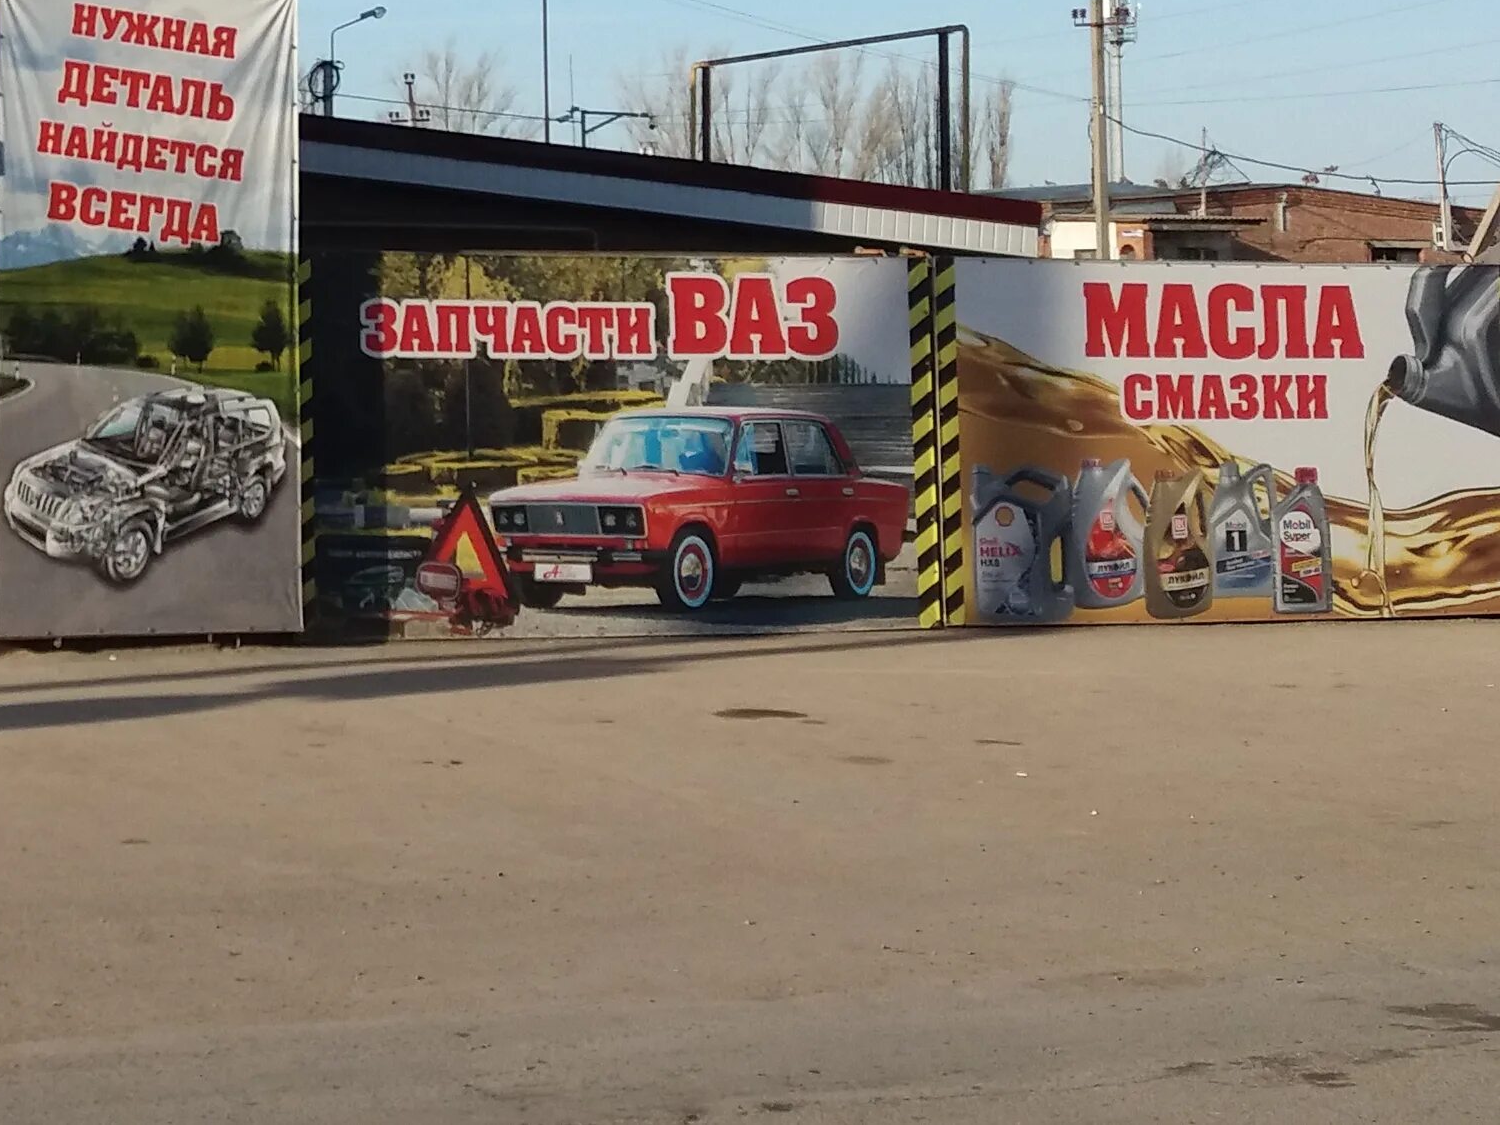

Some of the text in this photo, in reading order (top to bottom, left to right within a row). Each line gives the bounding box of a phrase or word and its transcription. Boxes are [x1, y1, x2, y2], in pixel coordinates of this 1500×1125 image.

[71, 2, 238, 59] НУЖНАЯ
[57, 60, 235, 122] ДЕТАЛЬ
[36, 120, 245, 182] НАЙДЕТСЯ
[46, 182, 221, 245] ВСЕГДА
[363, 276, 840, 357] ЗАПЧАСТИ ВАЗ
[1082, 282, 1365, 359] МАСЛА
[1123, 374, 1330, 420] СМАЗКИ
[1283, 519, 1311, 530] Mobil
[1283, 530, 1311, 542] Super
